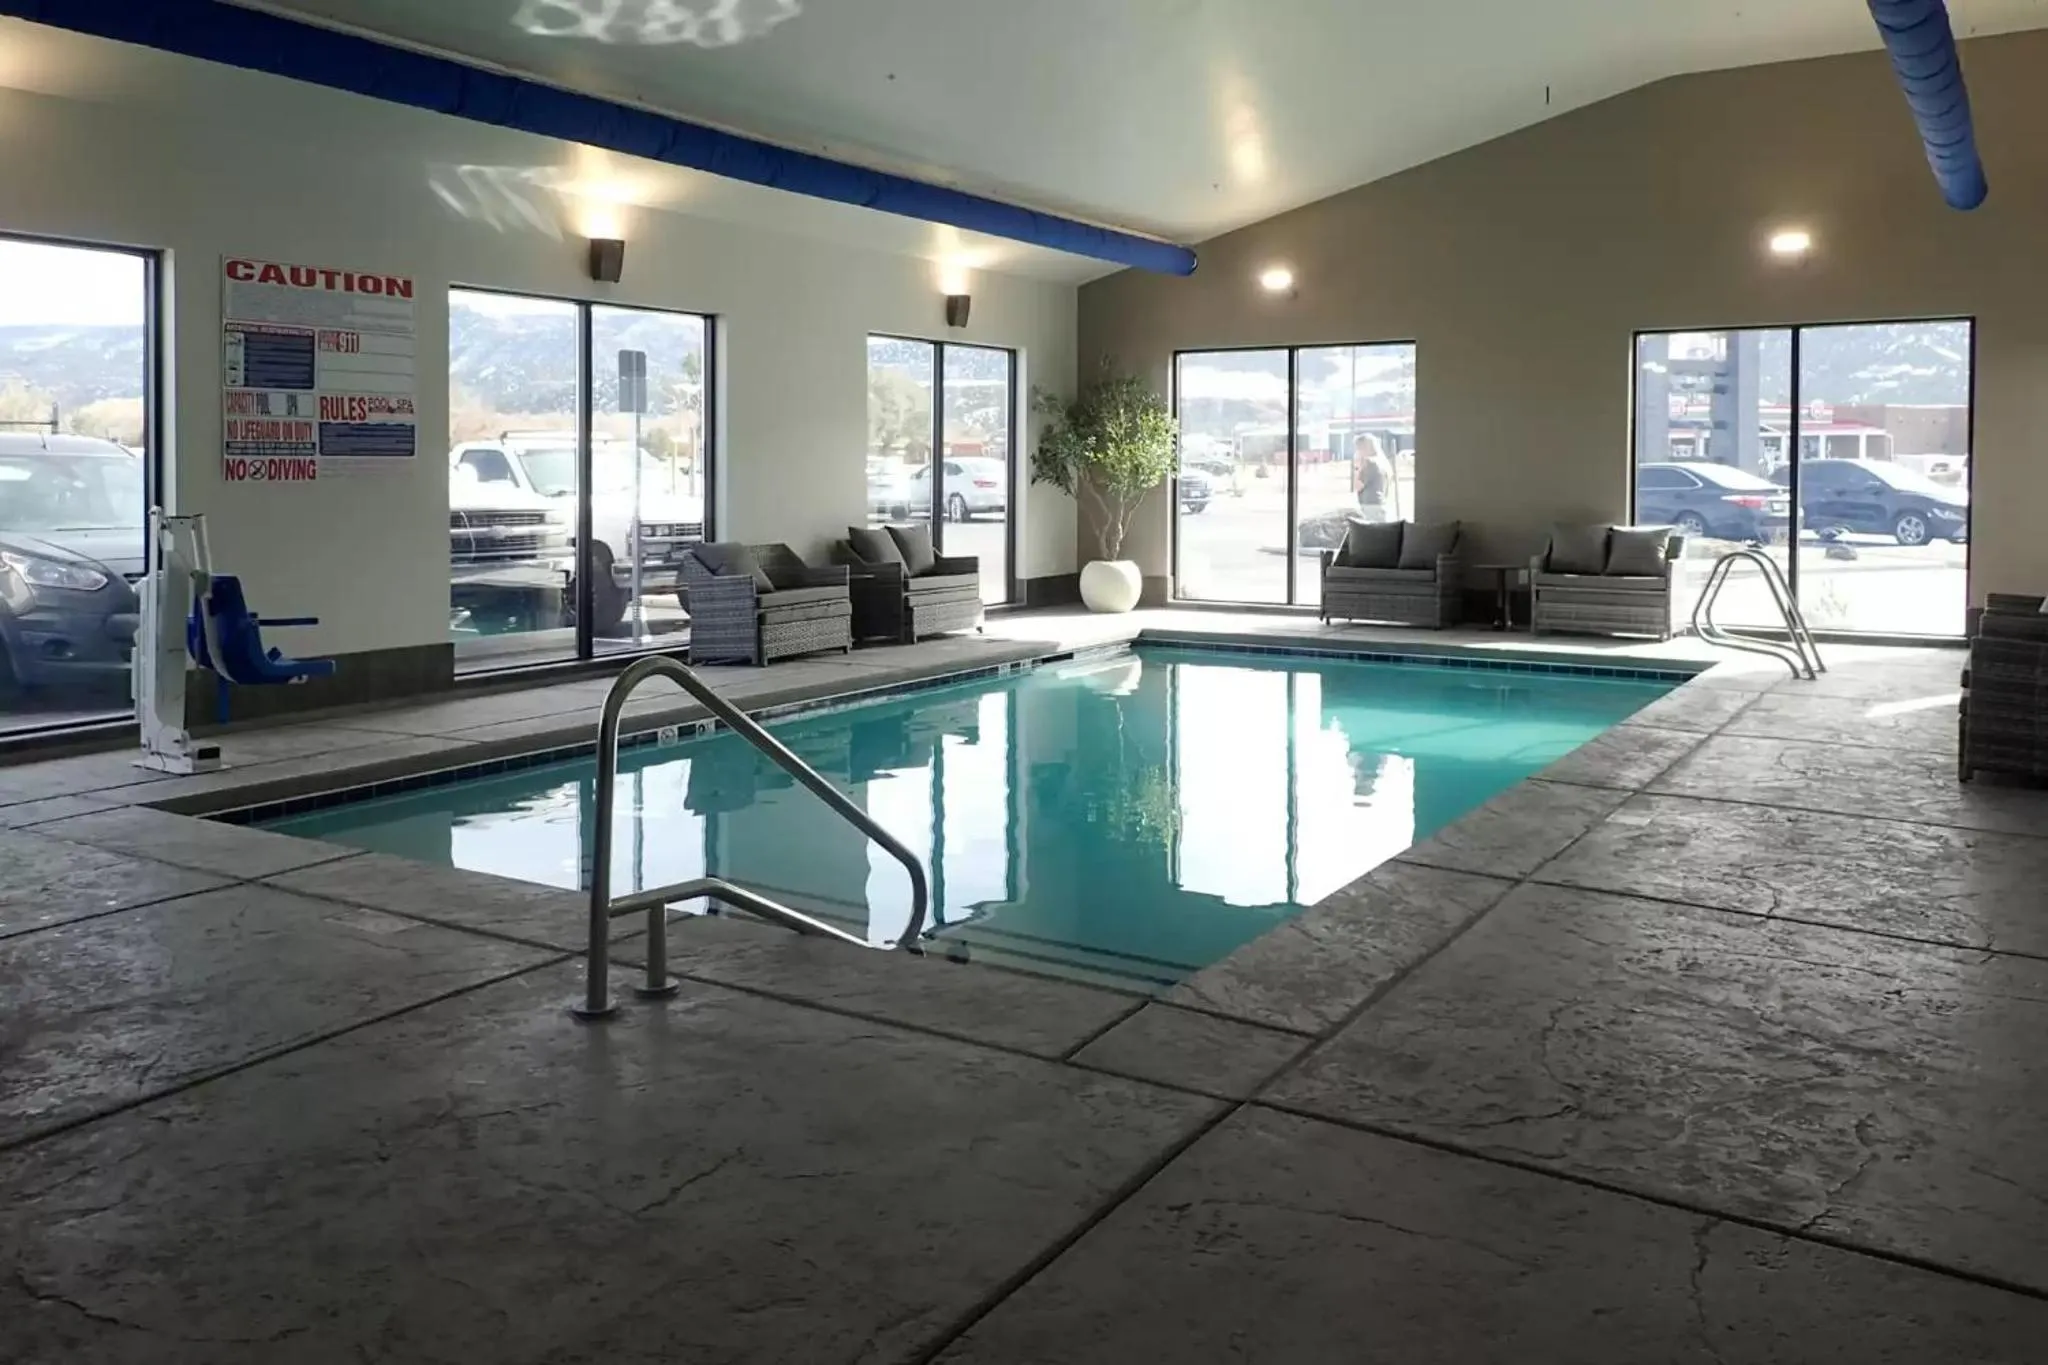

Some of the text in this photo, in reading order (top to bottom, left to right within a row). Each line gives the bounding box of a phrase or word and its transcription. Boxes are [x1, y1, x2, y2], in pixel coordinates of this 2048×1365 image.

[226, 260, 413, 298] CAUTION
[320, 396, 367, 421] RULES
[227, 420, 237, 440] NO
[239, 420, 280, 441] LIFEGUARD
[282, 421, 293, 441] ON
[294, 422, 312, 442] DUTY
[225, 458, 246, 481] NO
[268, 458, 317, 481] DIVING
